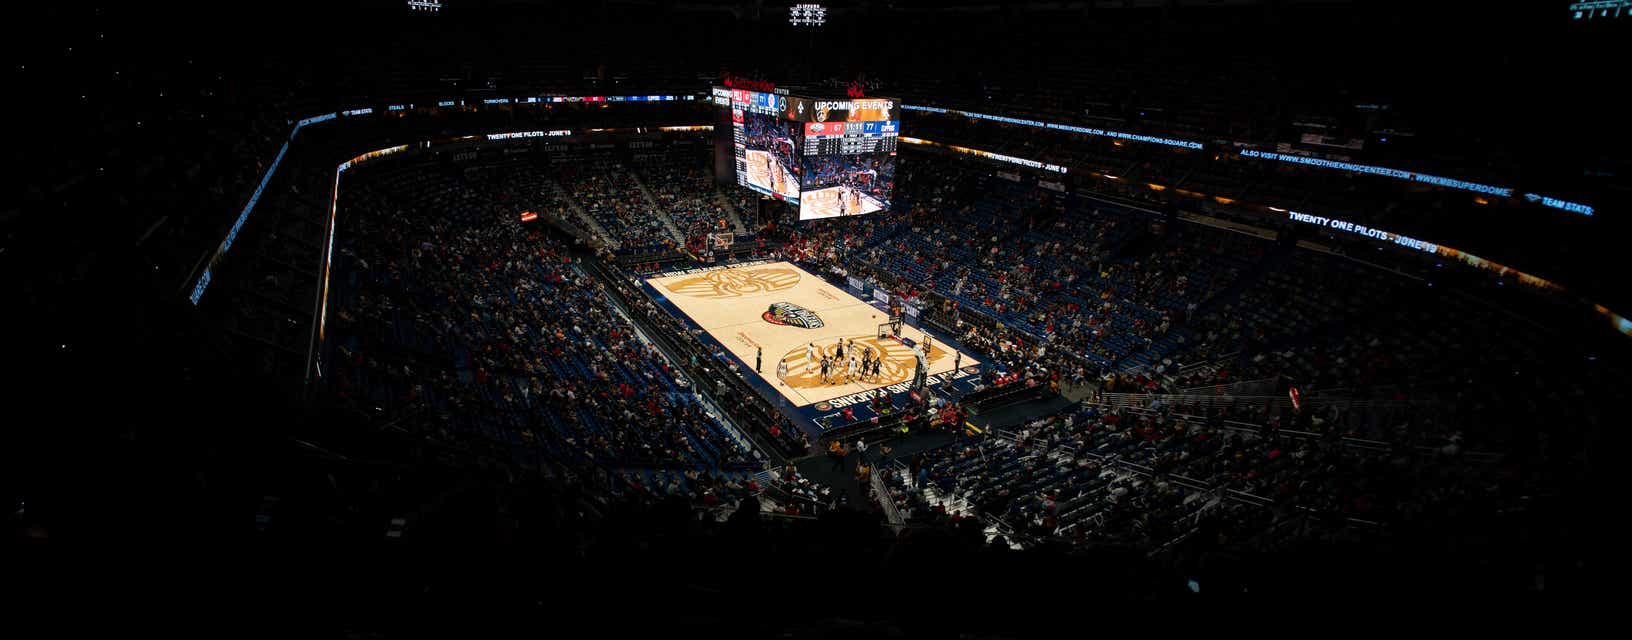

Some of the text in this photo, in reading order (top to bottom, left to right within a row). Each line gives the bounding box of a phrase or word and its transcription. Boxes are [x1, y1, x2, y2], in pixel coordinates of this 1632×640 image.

[815, 101, 893, 110] UPCOMING EVENTS
[846, 123, 862, 131] 11:11
[1240, 149, 1259, 158] ALSO
[1260, 151, 1278, 160] VISIT
[1045, 164, 1060, 172] JUNE
[1541, 197, 1594, 215] TEAM STATS:
[1289, 211, 1330, 226] TWENTY
[1331, 219, 1353, 231] ONE
[1354, 225, 1388, 240] PILOTS
[1394, 235, 1421, 249] JUNE
[1425, 243, 1438, 253] 19
